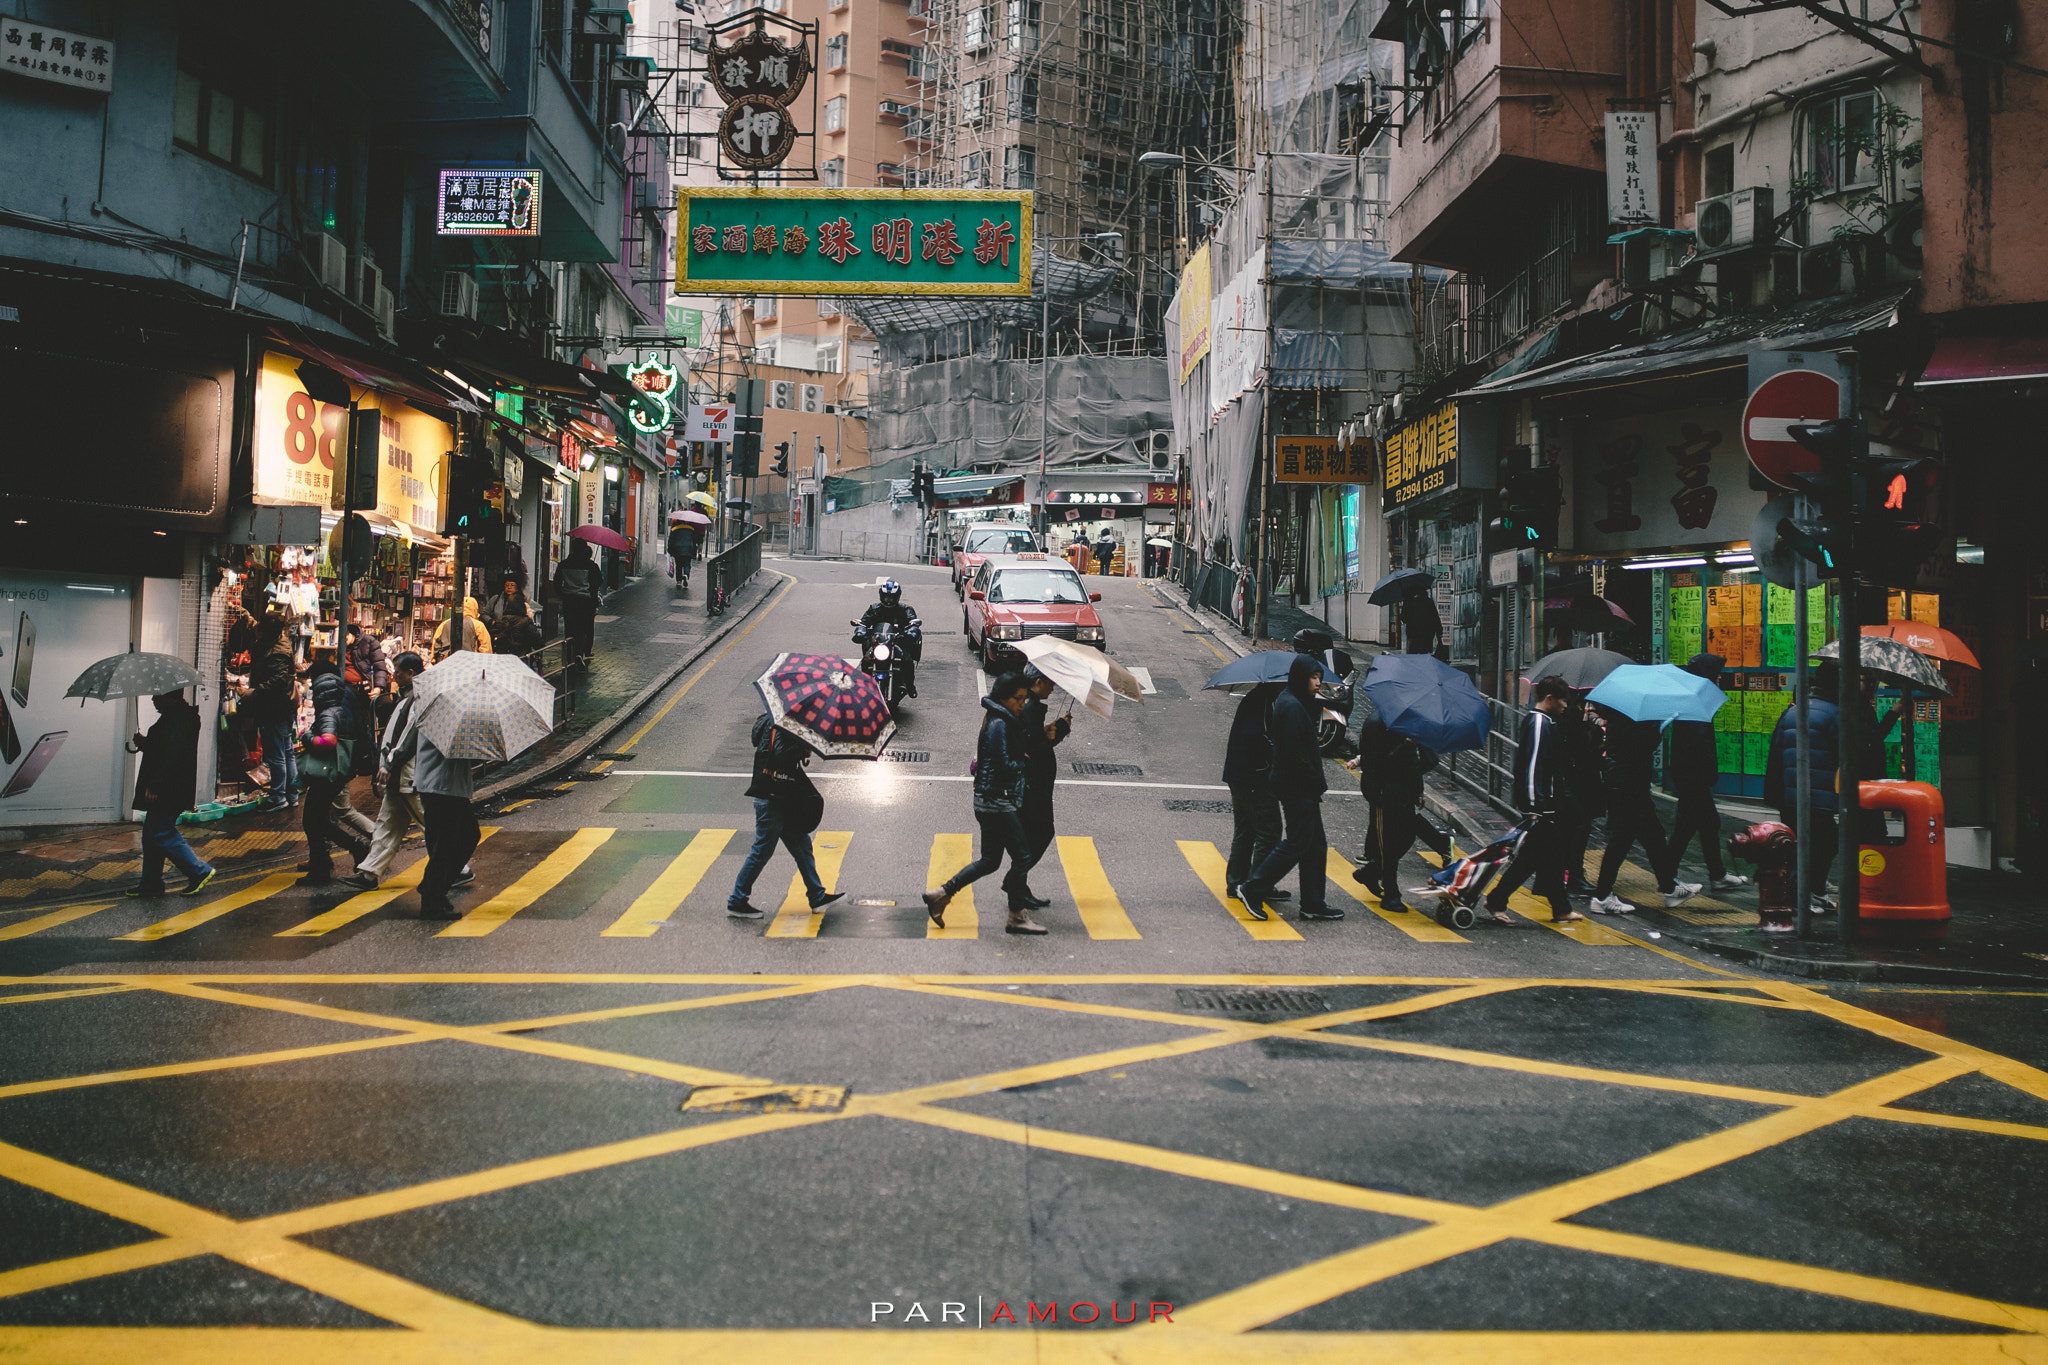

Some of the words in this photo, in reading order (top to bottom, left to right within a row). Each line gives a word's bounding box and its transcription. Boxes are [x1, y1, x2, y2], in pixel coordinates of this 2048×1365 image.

[720, 56, 790, 88] 順發
[731, 105, 782, 155] 押
[704, 408, 728, 439] 7
[1282, 443, 1368, 476] 富聯物業
[1386, 400, 1457, 490] 富聯物業
[1402, 480, 1421, 502] 2994
[1423, 469, 1445, 492] 6333
[0, 588, 28, 600] hone
